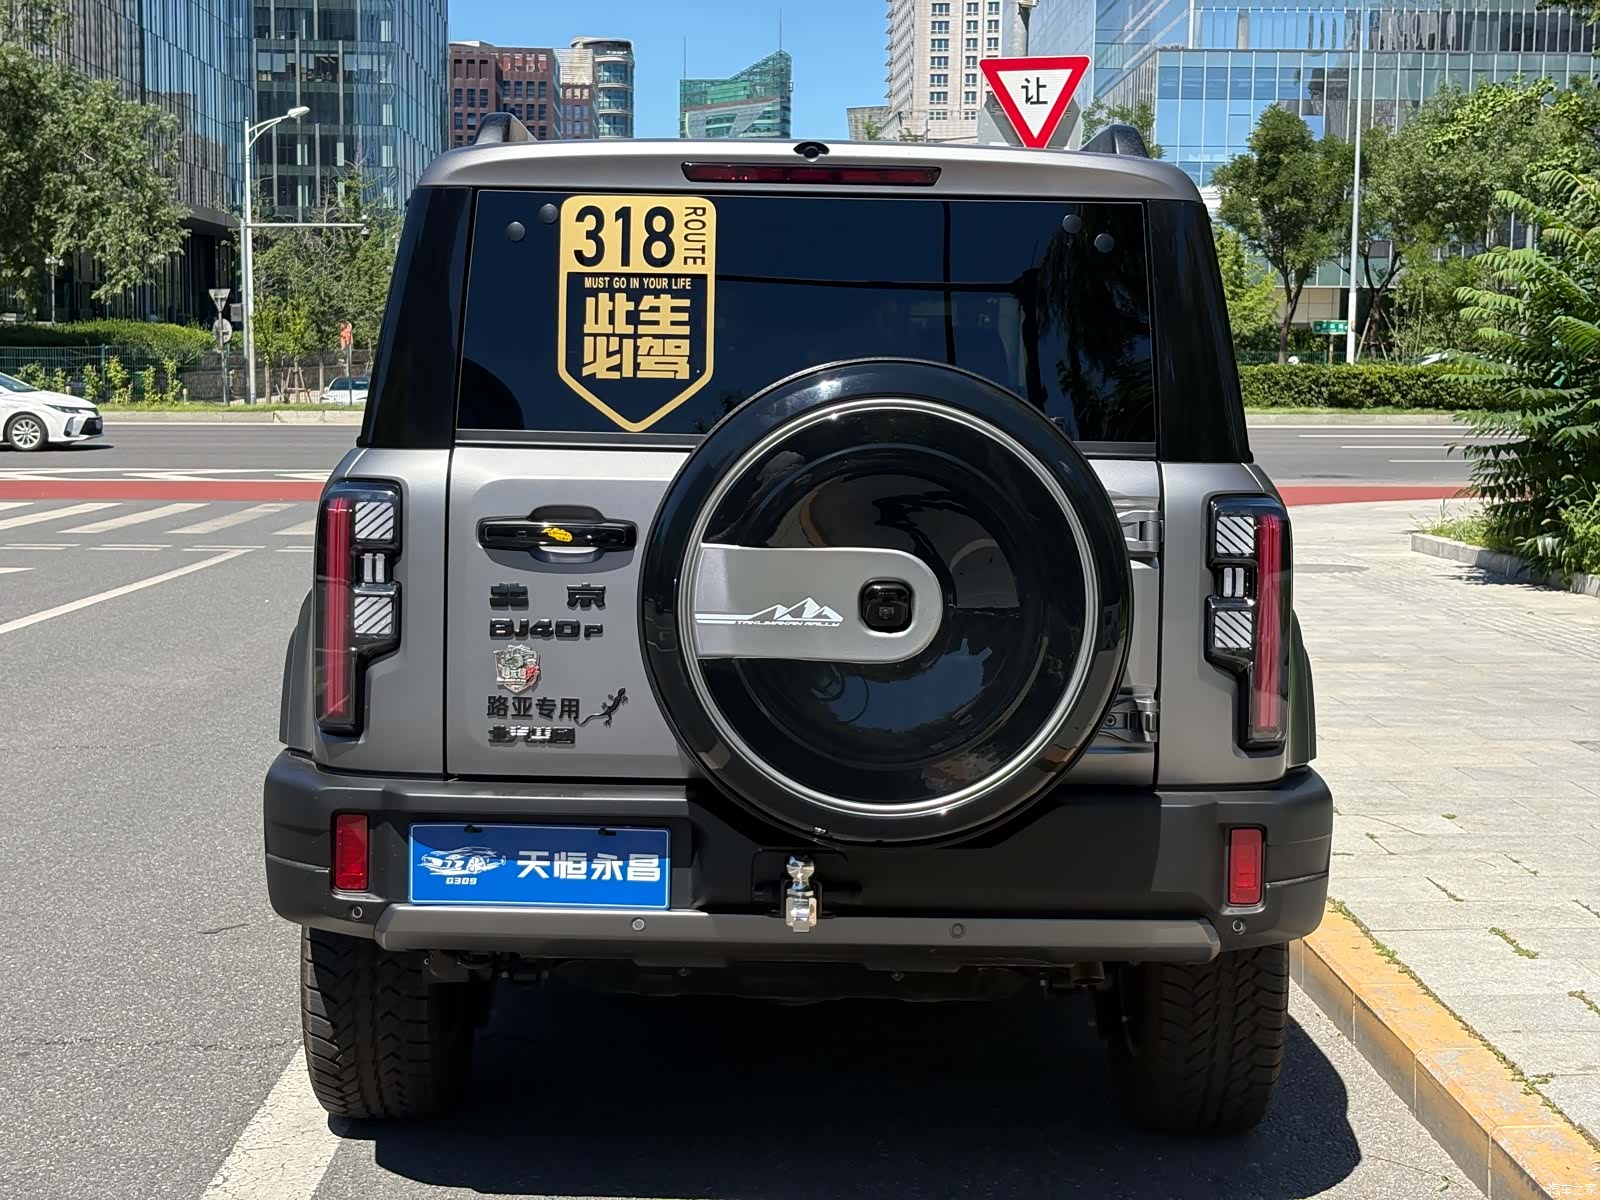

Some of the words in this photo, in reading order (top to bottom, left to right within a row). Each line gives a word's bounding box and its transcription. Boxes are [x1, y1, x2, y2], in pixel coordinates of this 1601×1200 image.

[1021, 77, 1048, 105] 让
[573, 205, 676, 268] 318
[683, 206, 707, 266] ROUTE
[584, 277, 610, 289] MUST
[613, 277, 627, 289] GO
[630, 277, 640, 289] IN
[643, 277, 669, 289] YOUR
[672, 278, 692, 290] LIFE
[584, 293, 691, 335] 此生
[582, 336, 690, 379] 必驾
[487, 695, 580, 720] 路亚专用
[516, 850, 661, 882] 天恒永昌
